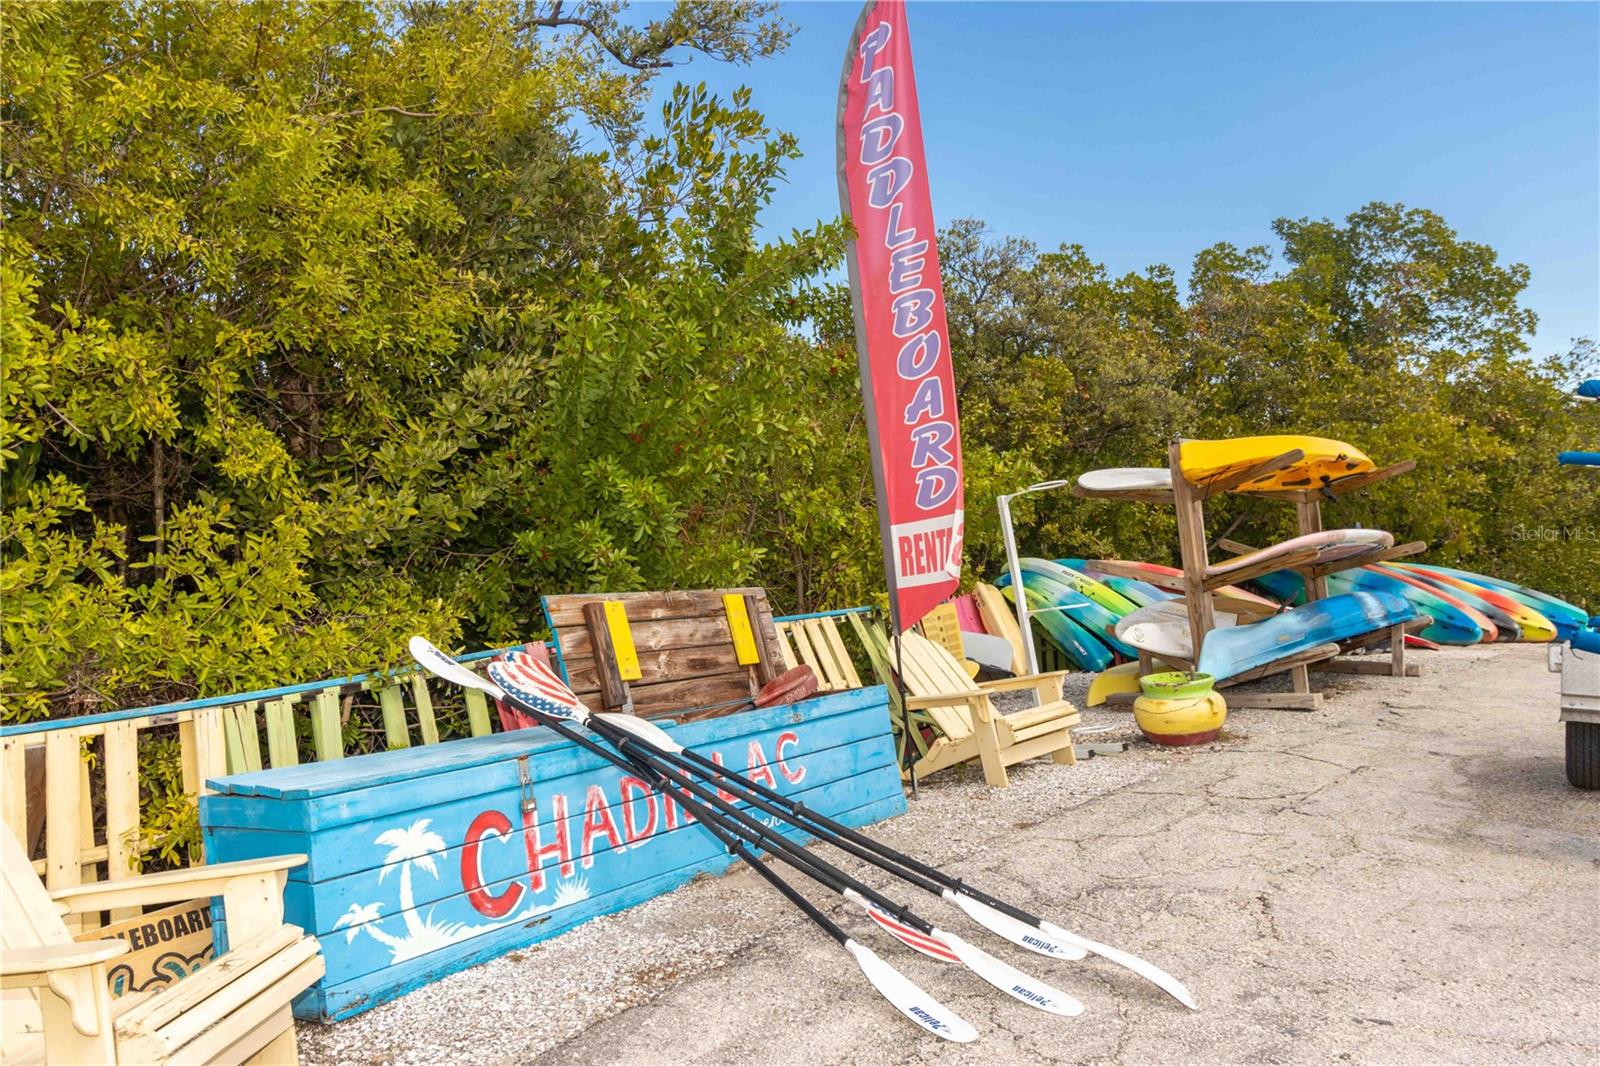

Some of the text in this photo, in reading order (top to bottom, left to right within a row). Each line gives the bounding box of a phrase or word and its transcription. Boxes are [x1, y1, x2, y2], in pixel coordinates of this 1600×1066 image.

[860, 21, 958, 510] PADDLEBOARD
[1022, 935, 1057, 953] Pelican
[1012, 985, 1051, 1006] Pelican
